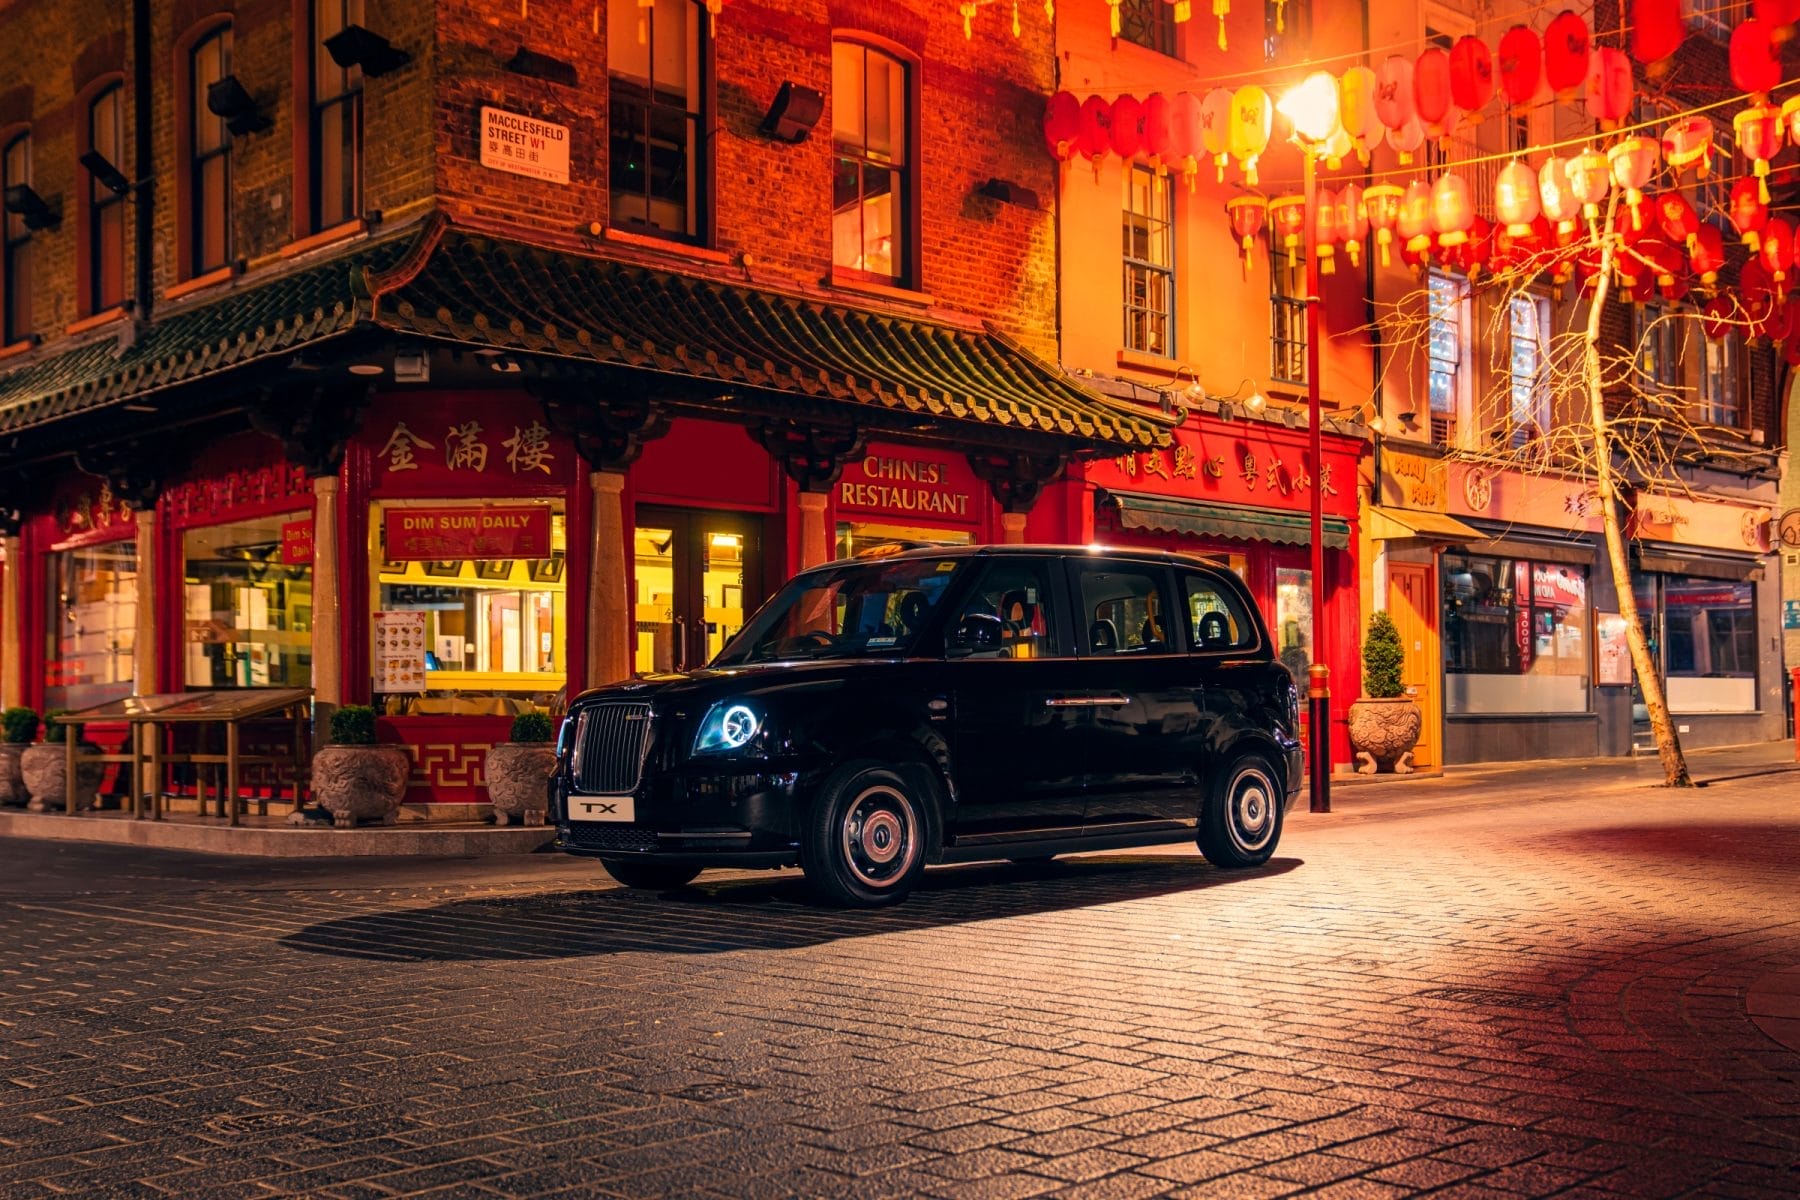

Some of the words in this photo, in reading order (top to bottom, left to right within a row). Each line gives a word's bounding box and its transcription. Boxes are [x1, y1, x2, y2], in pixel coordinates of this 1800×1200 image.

[488, 112, 563, 141] MACCLESFIELD
[488, 126, 527, 145] STREET
[530, 136, 545, 151] W1
[377, 420, 555, 475] 金滿樓
[863, 456, 950, 485] CHINESE
[842, 482, 969, 515] RESTAURANT
[404, 517, 435, 530] DIM
[440, 516, 477, 529] SUM
[483, 515, 530, 529] DAILY
[579, 802, 618, 814] TX
